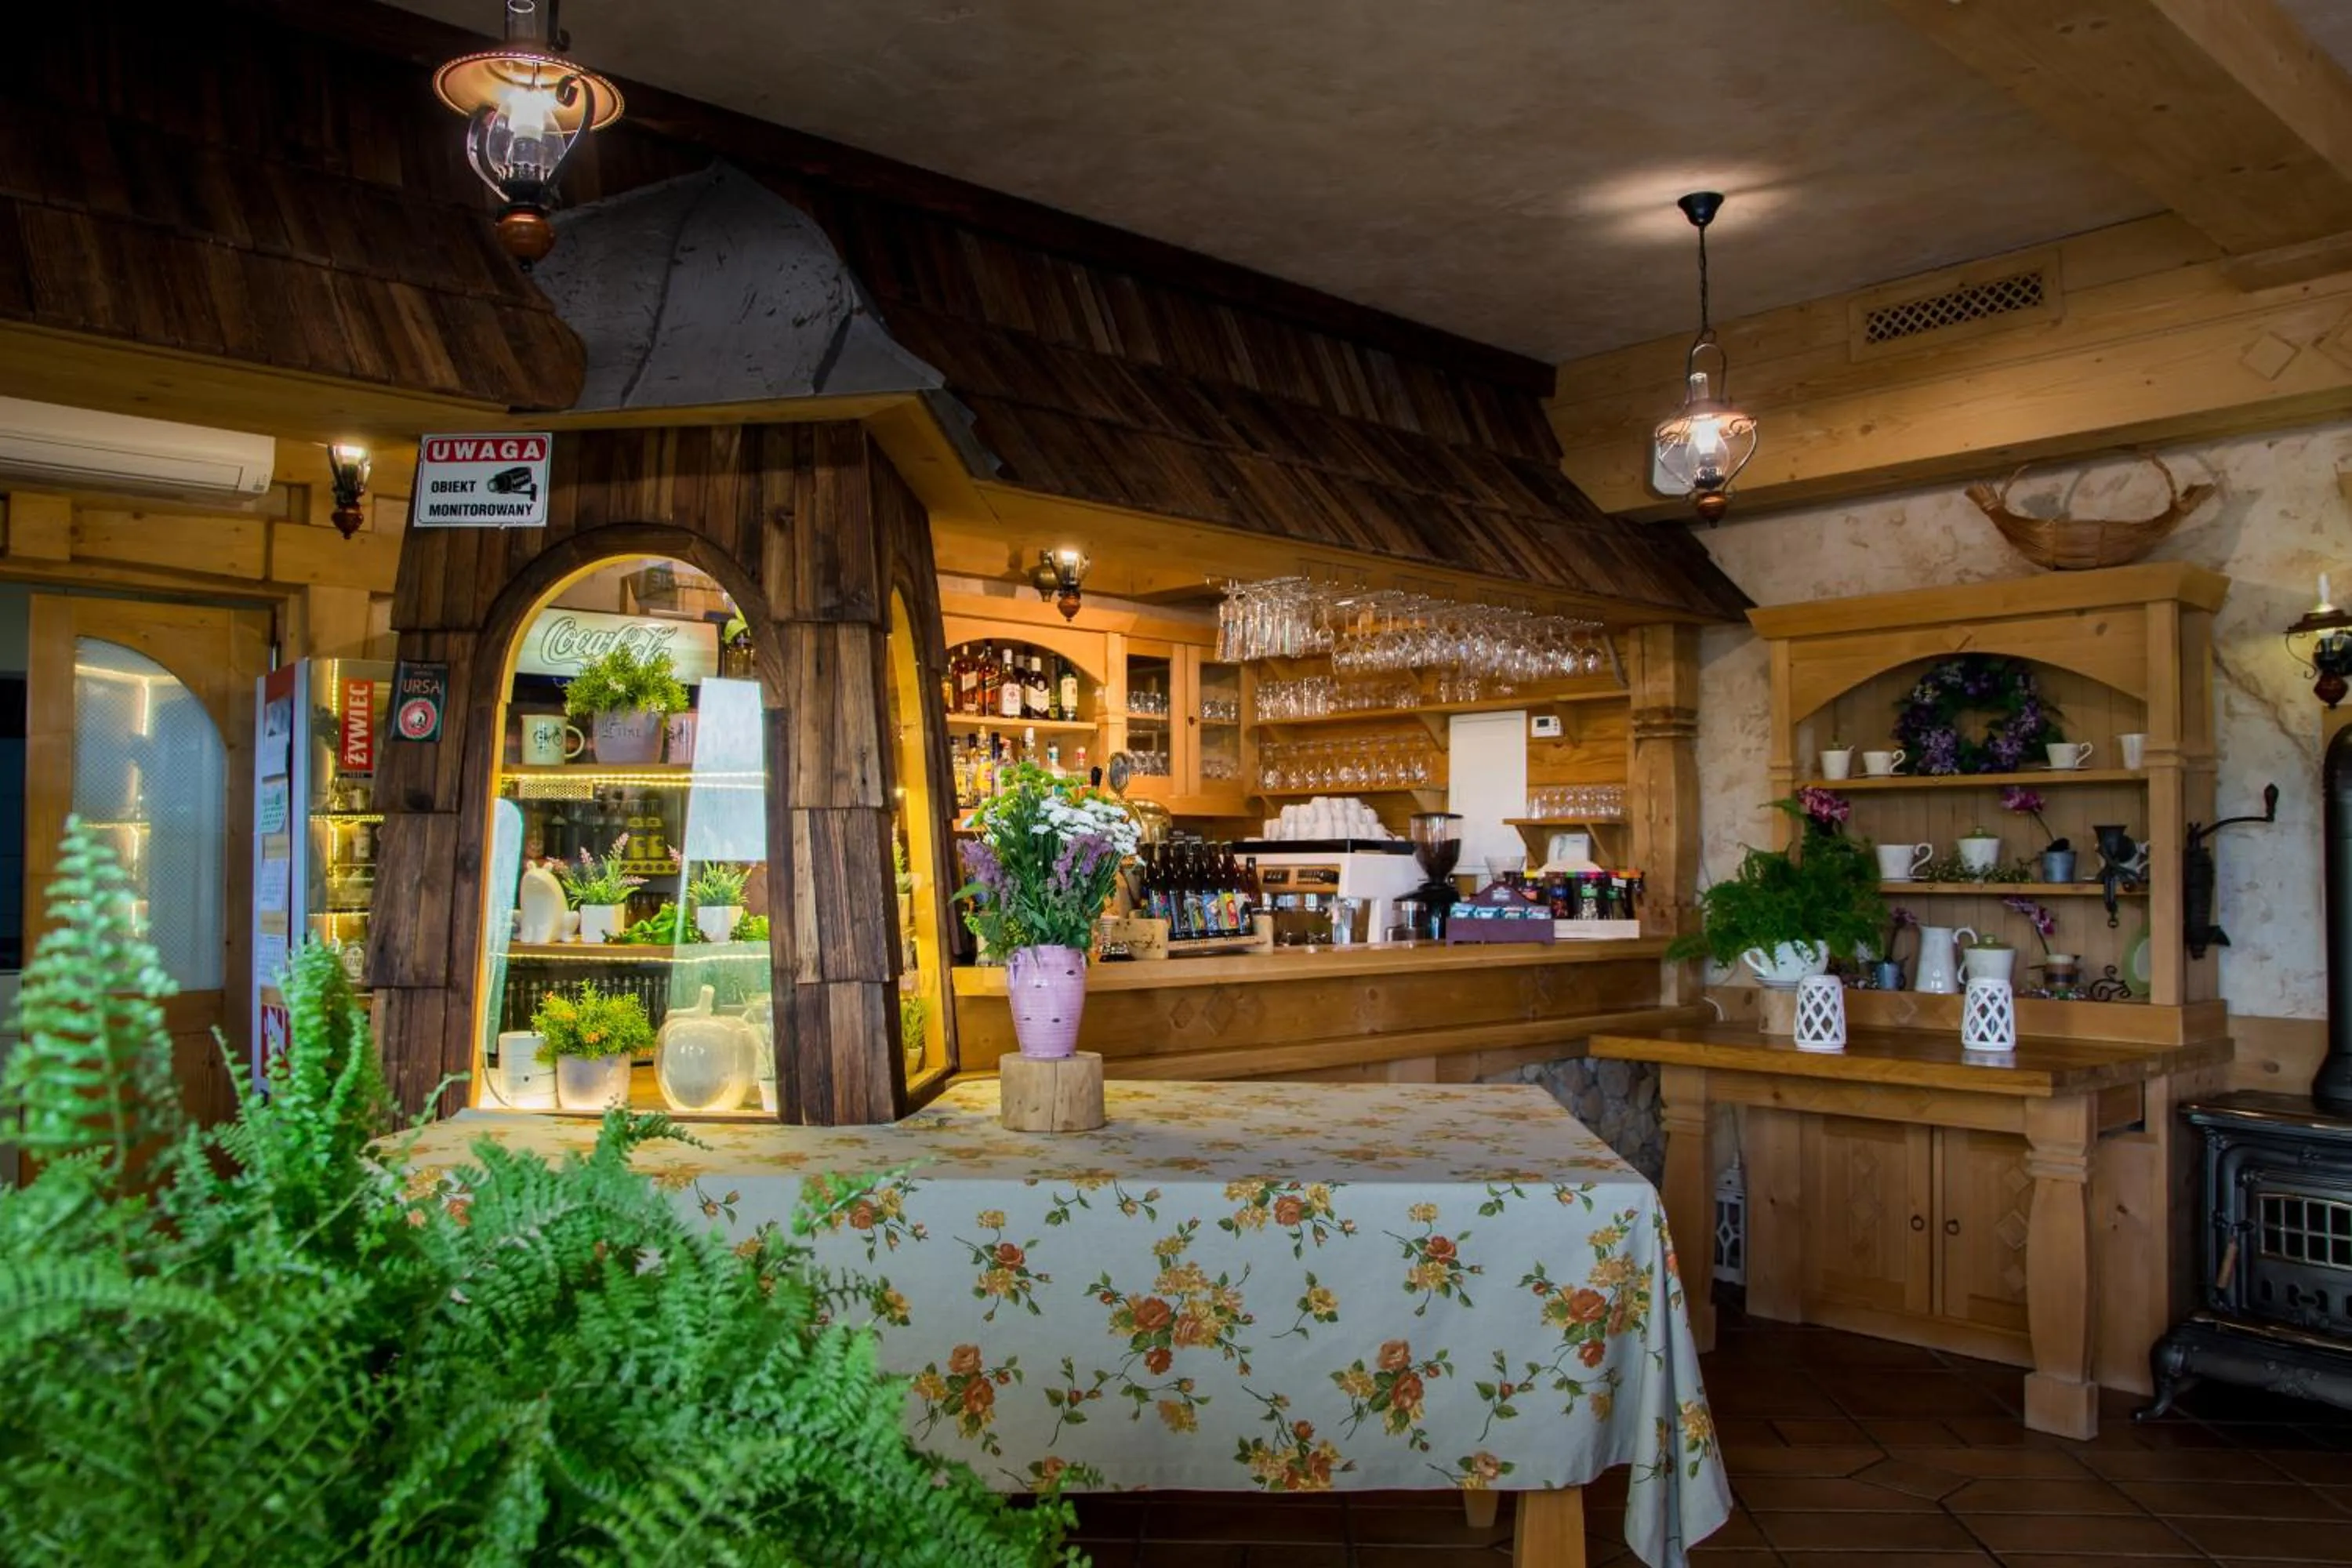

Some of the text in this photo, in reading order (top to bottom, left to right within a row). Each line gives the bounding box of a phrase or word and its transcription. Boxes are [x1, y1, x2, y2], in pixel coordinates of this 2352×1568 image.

[431, 440, 541, 461] UWAGA
[431, 481, 477, 493] OBIEKT
[429, 503, 534, 517] MONITOROWANY
[401, 679, 440, 694] URSA
[344, 684, 368, 765] ŻYWIEC
